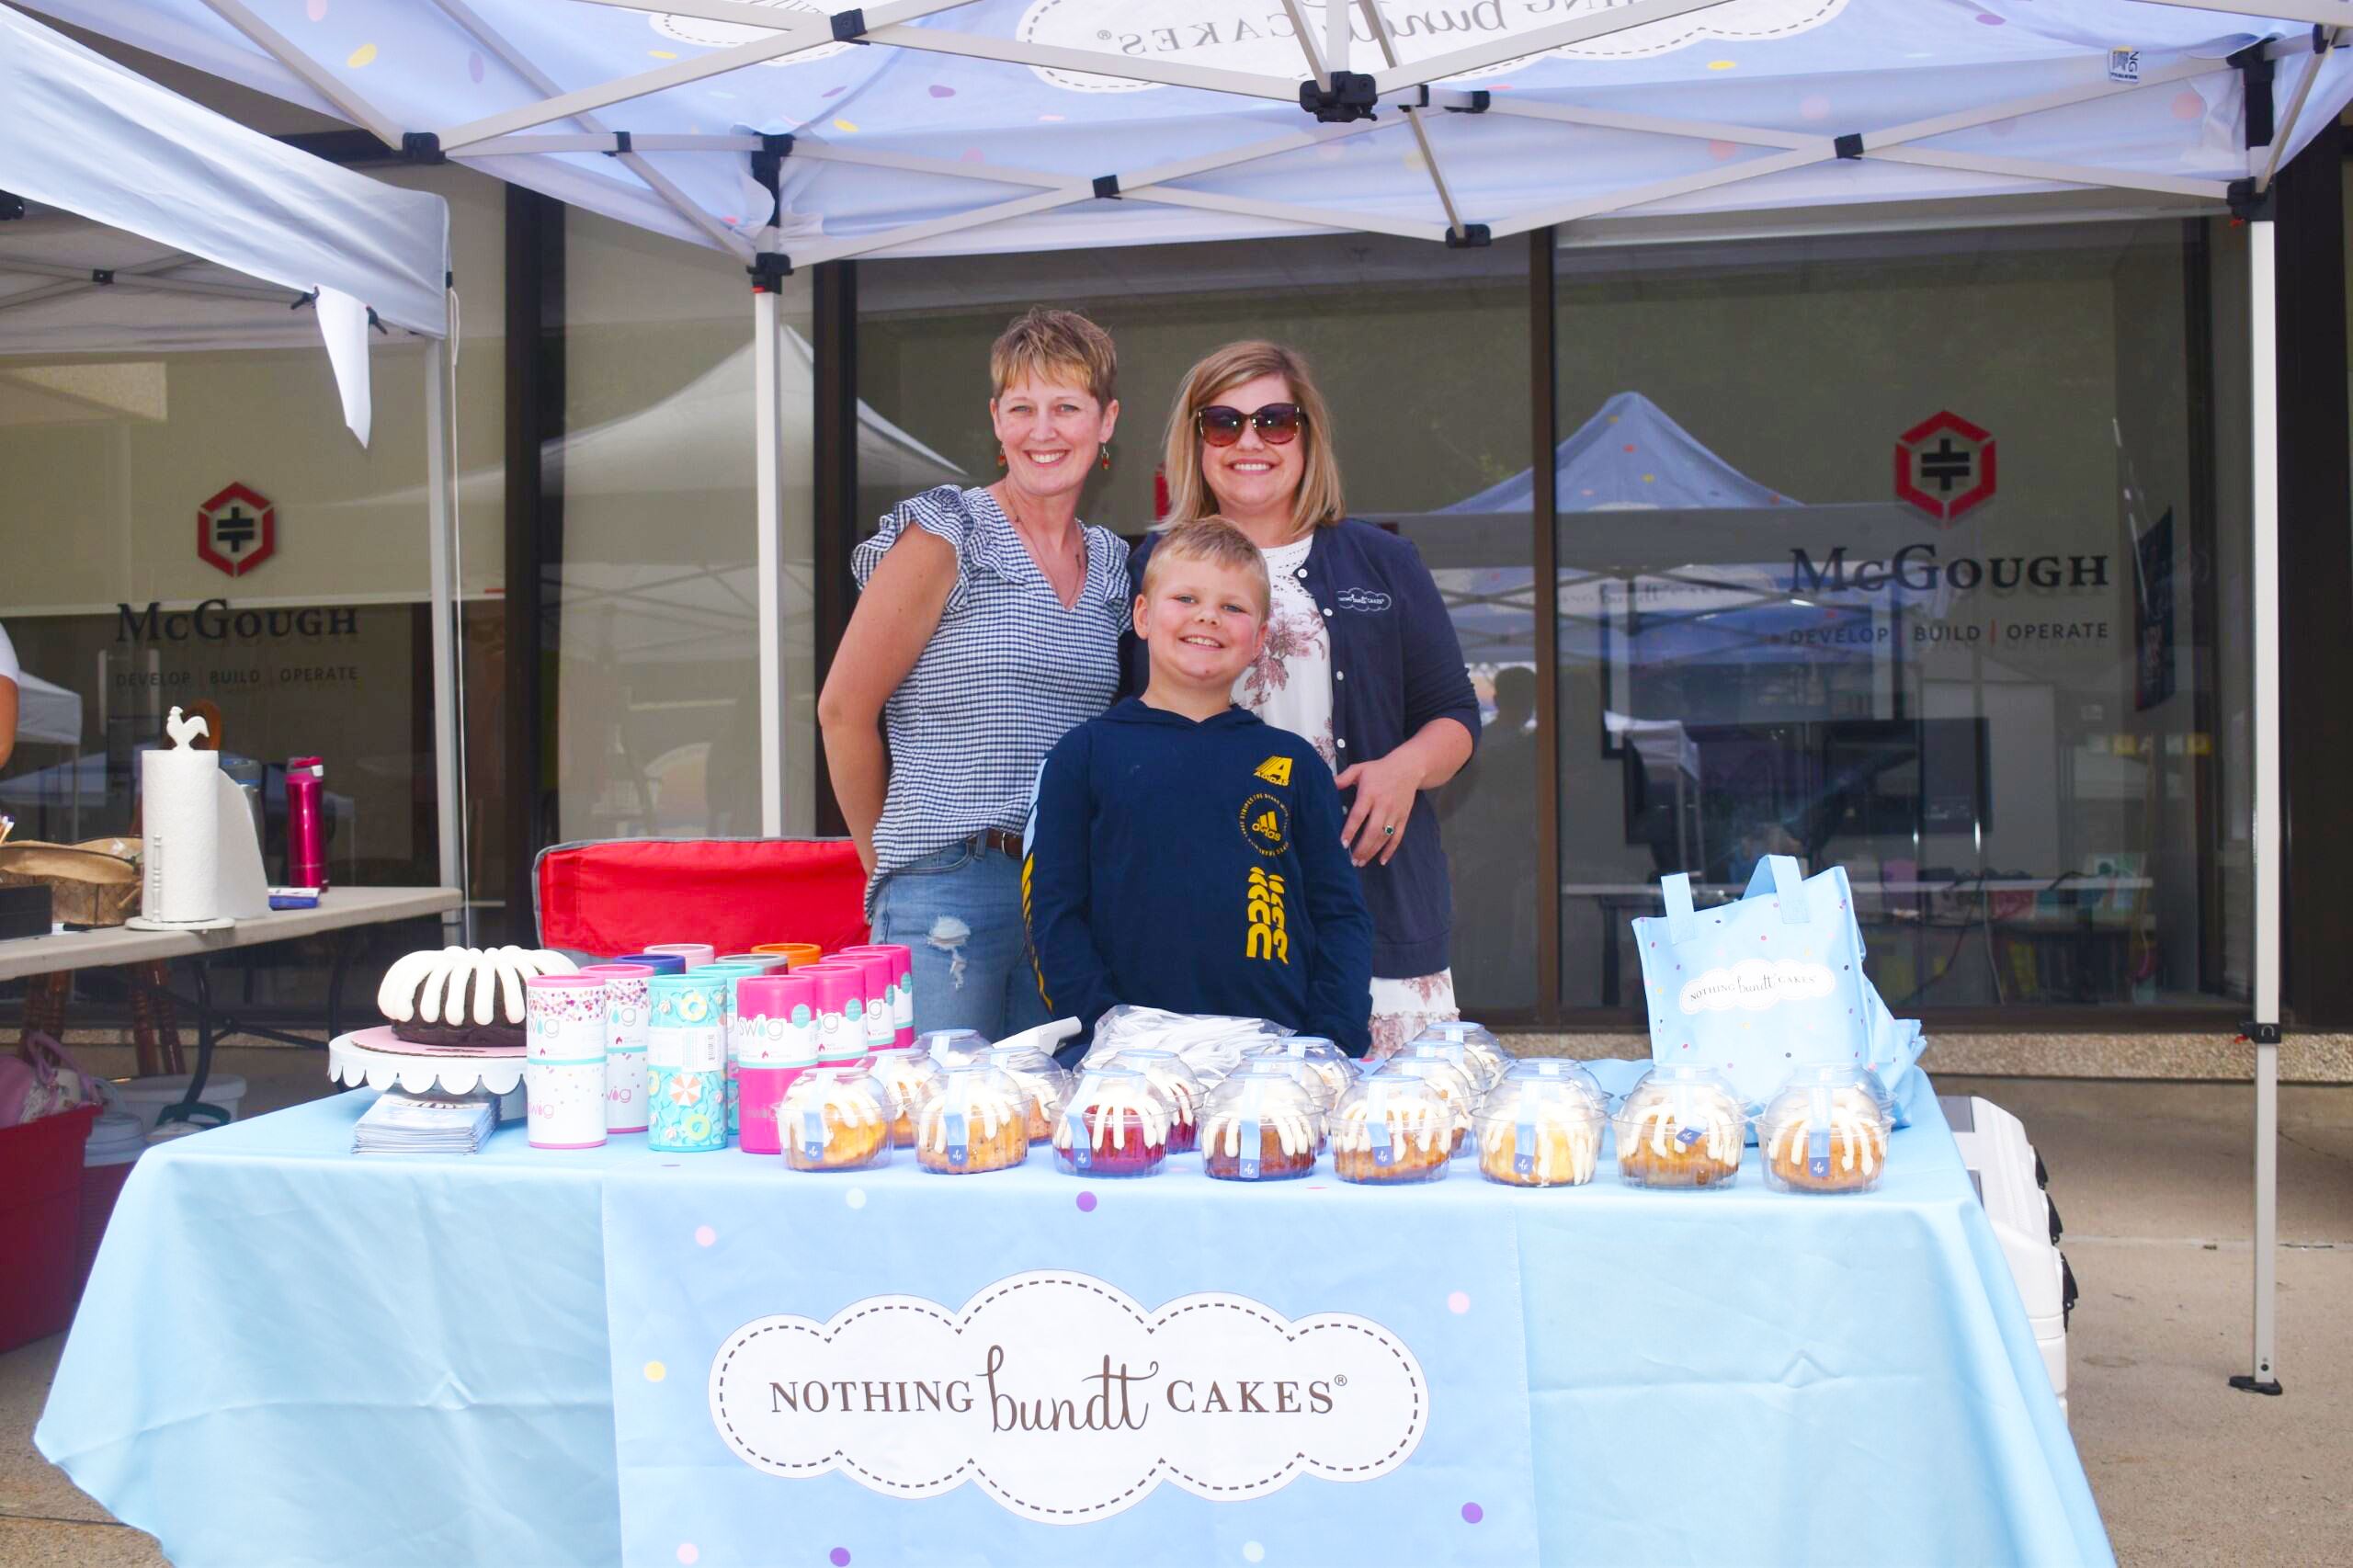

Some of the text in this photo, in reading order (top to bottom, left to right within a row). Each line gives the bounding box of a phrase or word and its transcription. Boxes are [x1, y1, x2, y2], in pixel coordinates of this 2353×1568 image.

[1790, 621, 2109, 644] DEVELOP BUILD OPERATE
[117, 665, 358, 687] DEVELOP BUILD OPERATE
[1690, 984, 1735, 1002] NOTHING
[1737, 974, 1773, 994] bundt
[770, 1380, 974, 1415] NOTHING
[976, 1345, 1160, 1434] bundt
